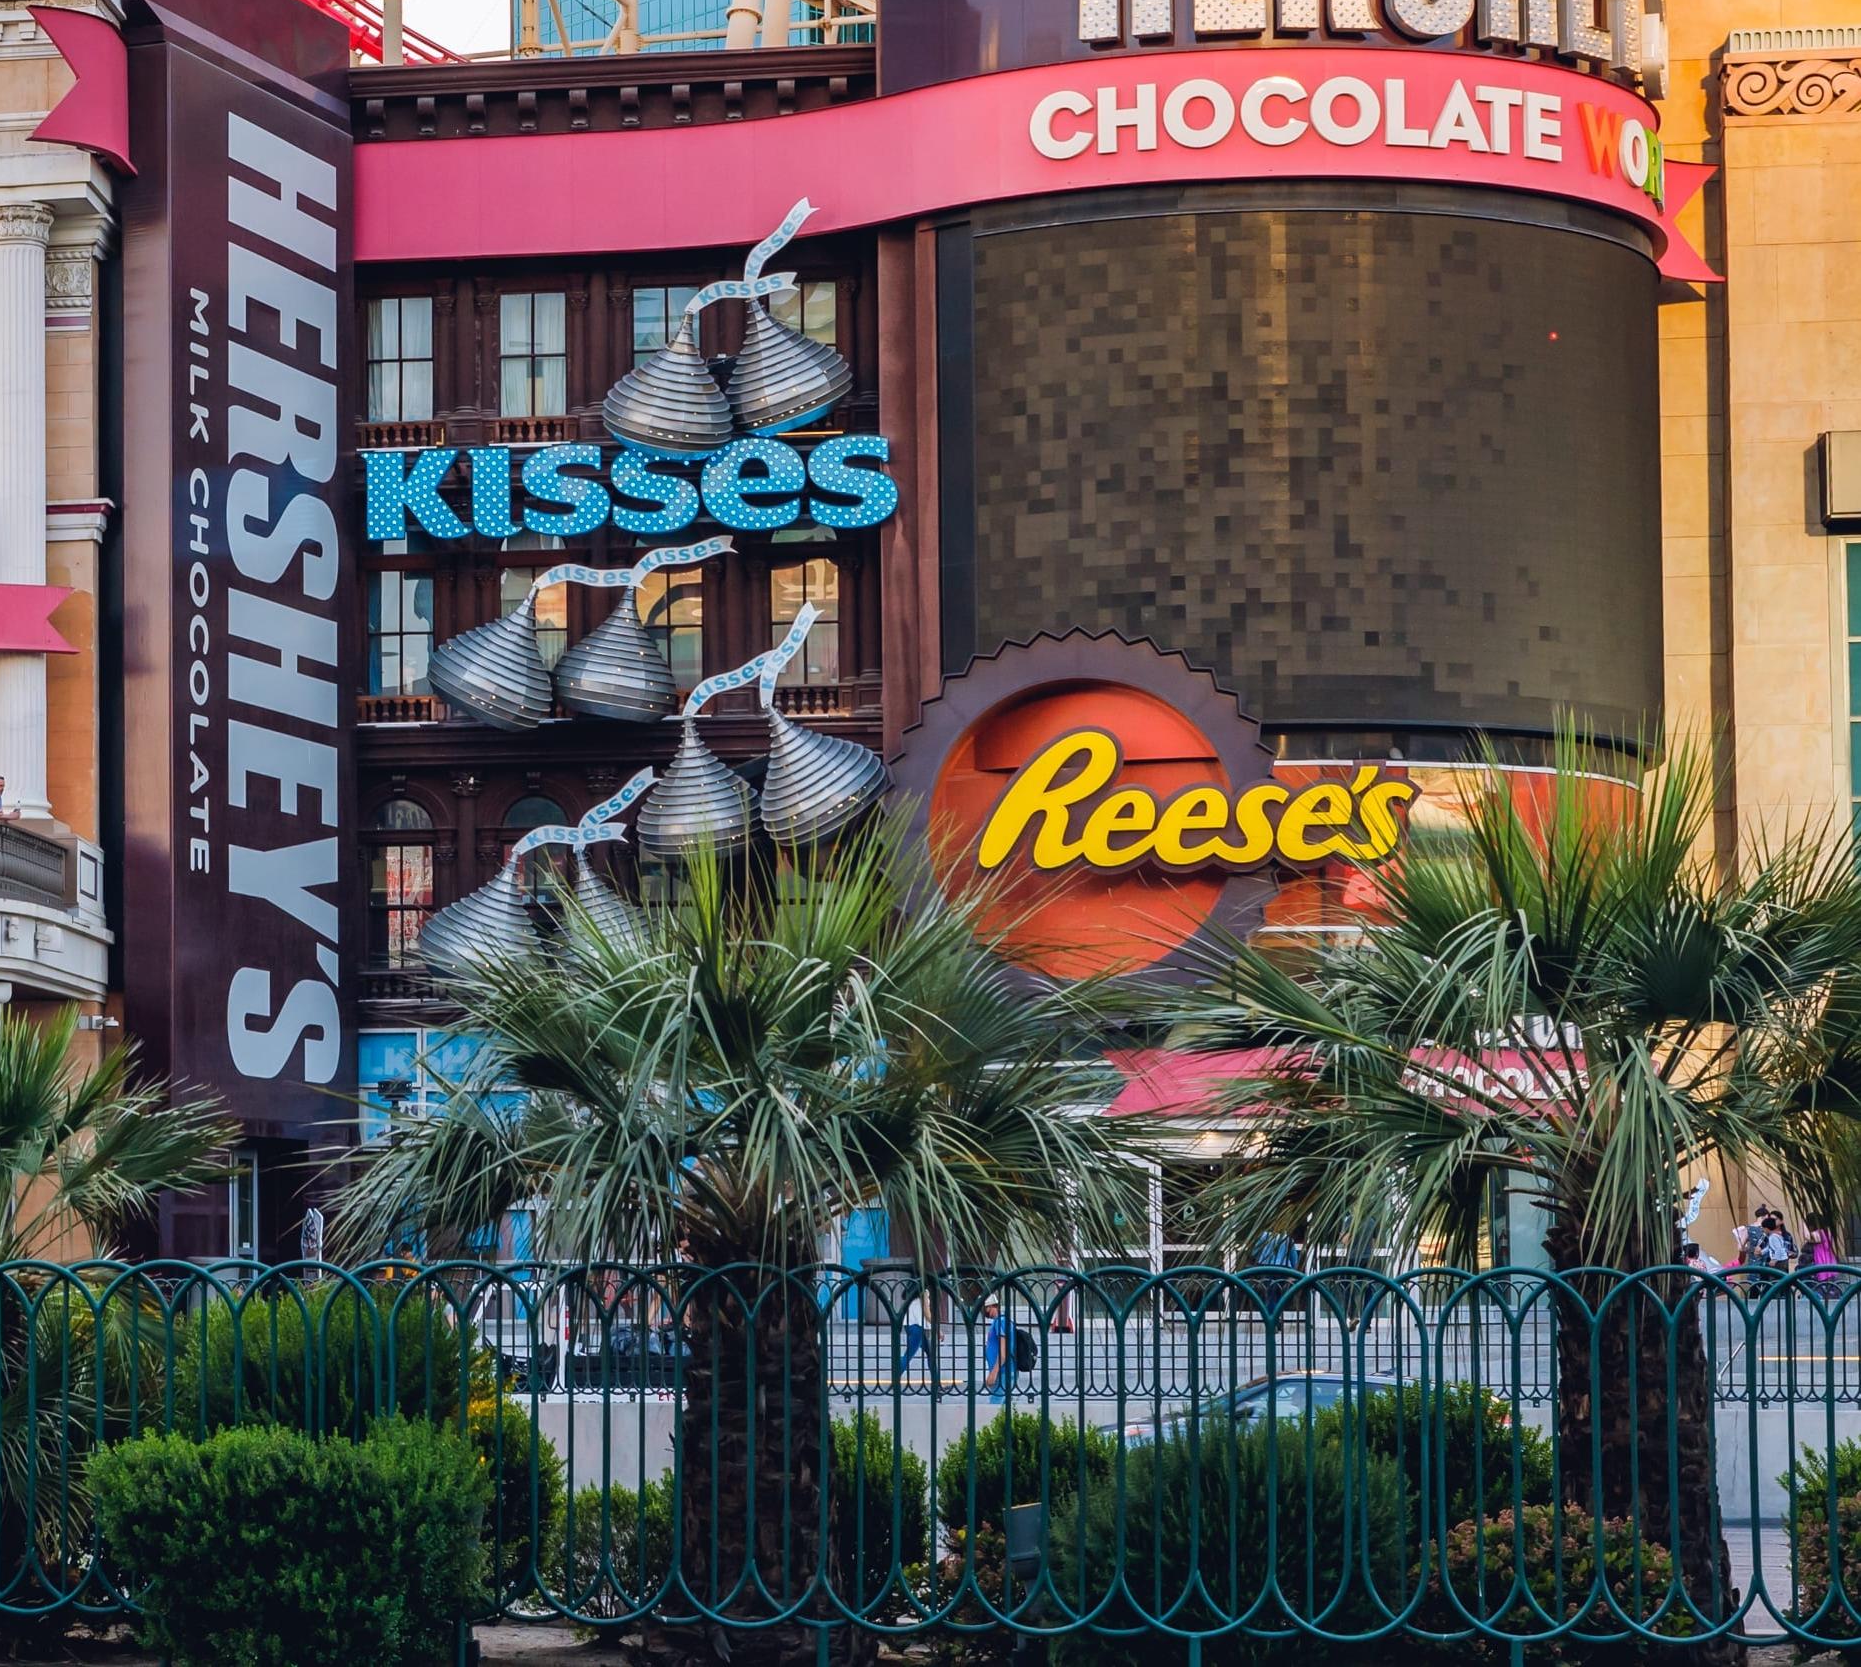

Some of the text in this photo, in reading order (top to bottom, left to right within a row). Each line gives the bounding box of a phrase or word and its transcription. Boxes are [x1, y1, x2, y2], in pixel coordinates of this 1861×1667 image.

[1030, 76, 1665, 214] CHOCOLATE WOR
[189, 287, 210, 875] MILK CHOCOLATE
[227, 110, 341, 1084] HERSHEY'S
[581, 778, 646, 828] isses
[979, 731, 1414, 868] Reese's
